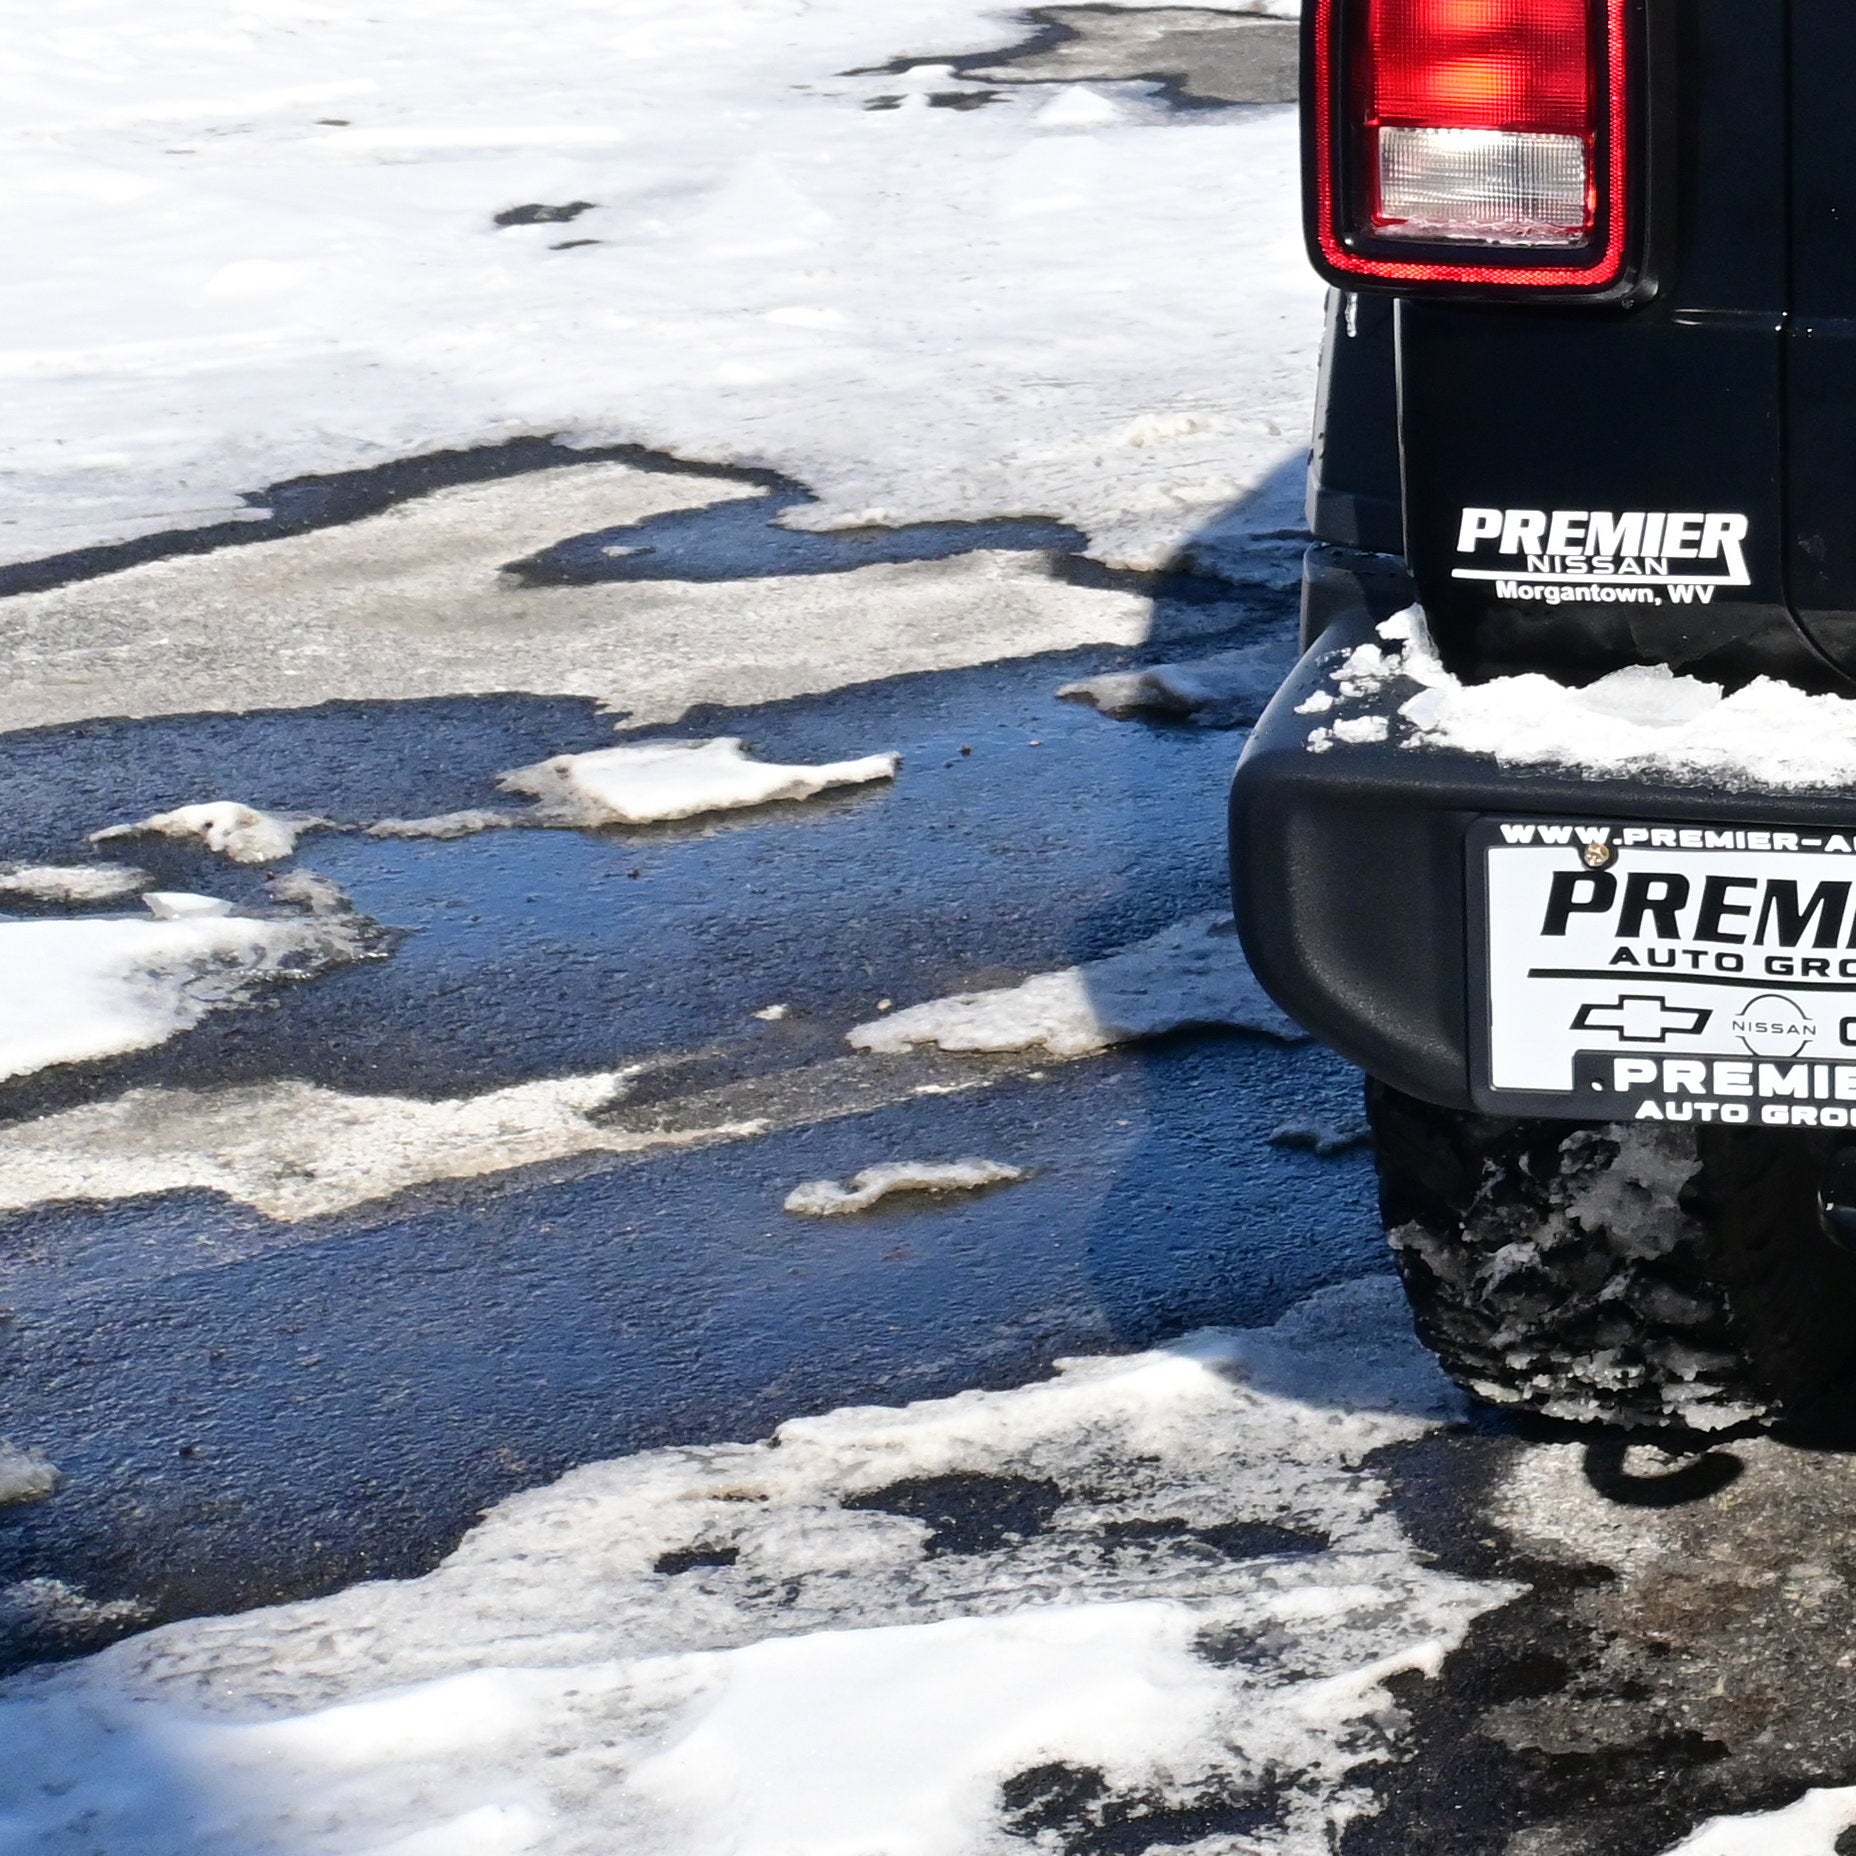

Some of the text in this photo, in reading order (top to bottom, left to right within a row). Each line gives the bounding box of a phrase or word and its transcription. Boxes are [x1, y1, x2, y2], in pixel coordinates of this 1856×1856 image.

[1456, 507, 1751, 585] PREMIER
[1527, 554, 1670, 576] NISSAN
[1495, 580, 1715, 606] Morgantown, WV
[1608, 945, 1745, 973] AUTO
[1731, 1019, 1817, 1037] NISSAN
[1633, 1099, 1746, 1124] AUTO
